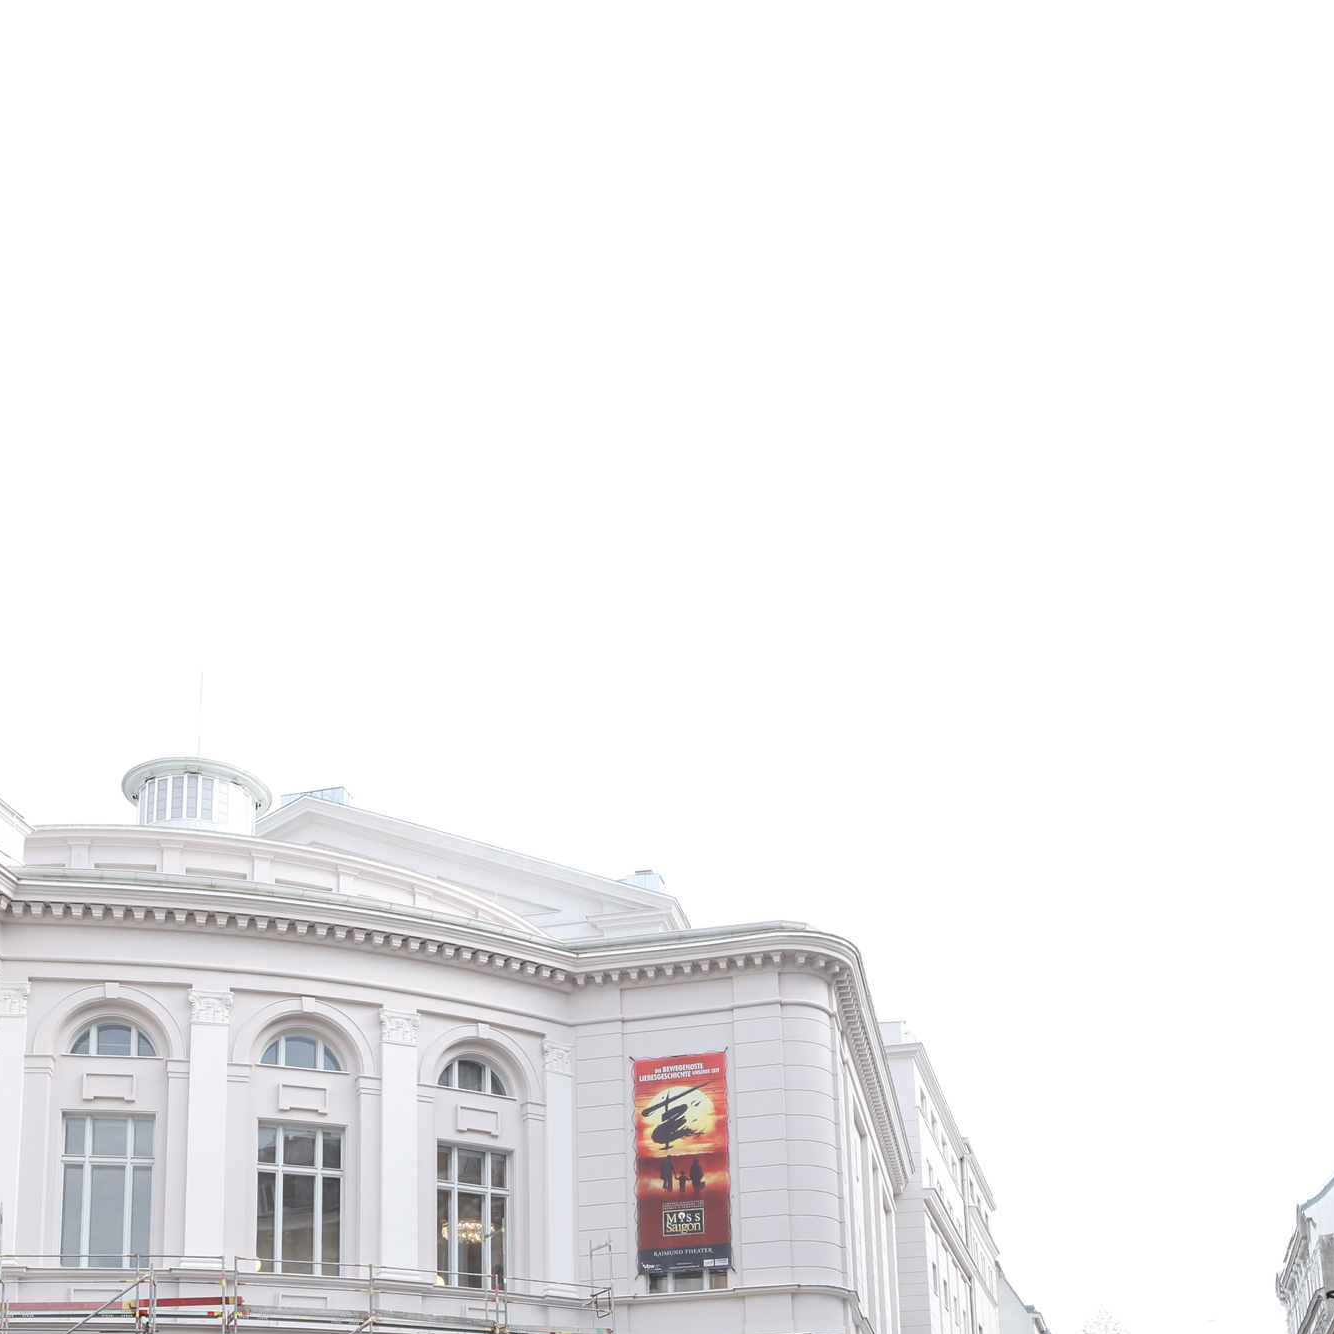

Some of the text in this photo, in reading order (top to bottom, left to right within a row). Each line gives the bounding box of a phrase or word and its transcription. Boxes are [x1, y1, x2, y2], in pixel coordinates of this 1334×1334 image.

[662, 1063, 704, 1072] BEWEGENDSTE
[639, 1071, 691, 1082] LIEBESGESCHICHTE
[666, 1222, 701, 1234] Saigon
[653, 1247, 715, 1257] RAIMUND THEATER
